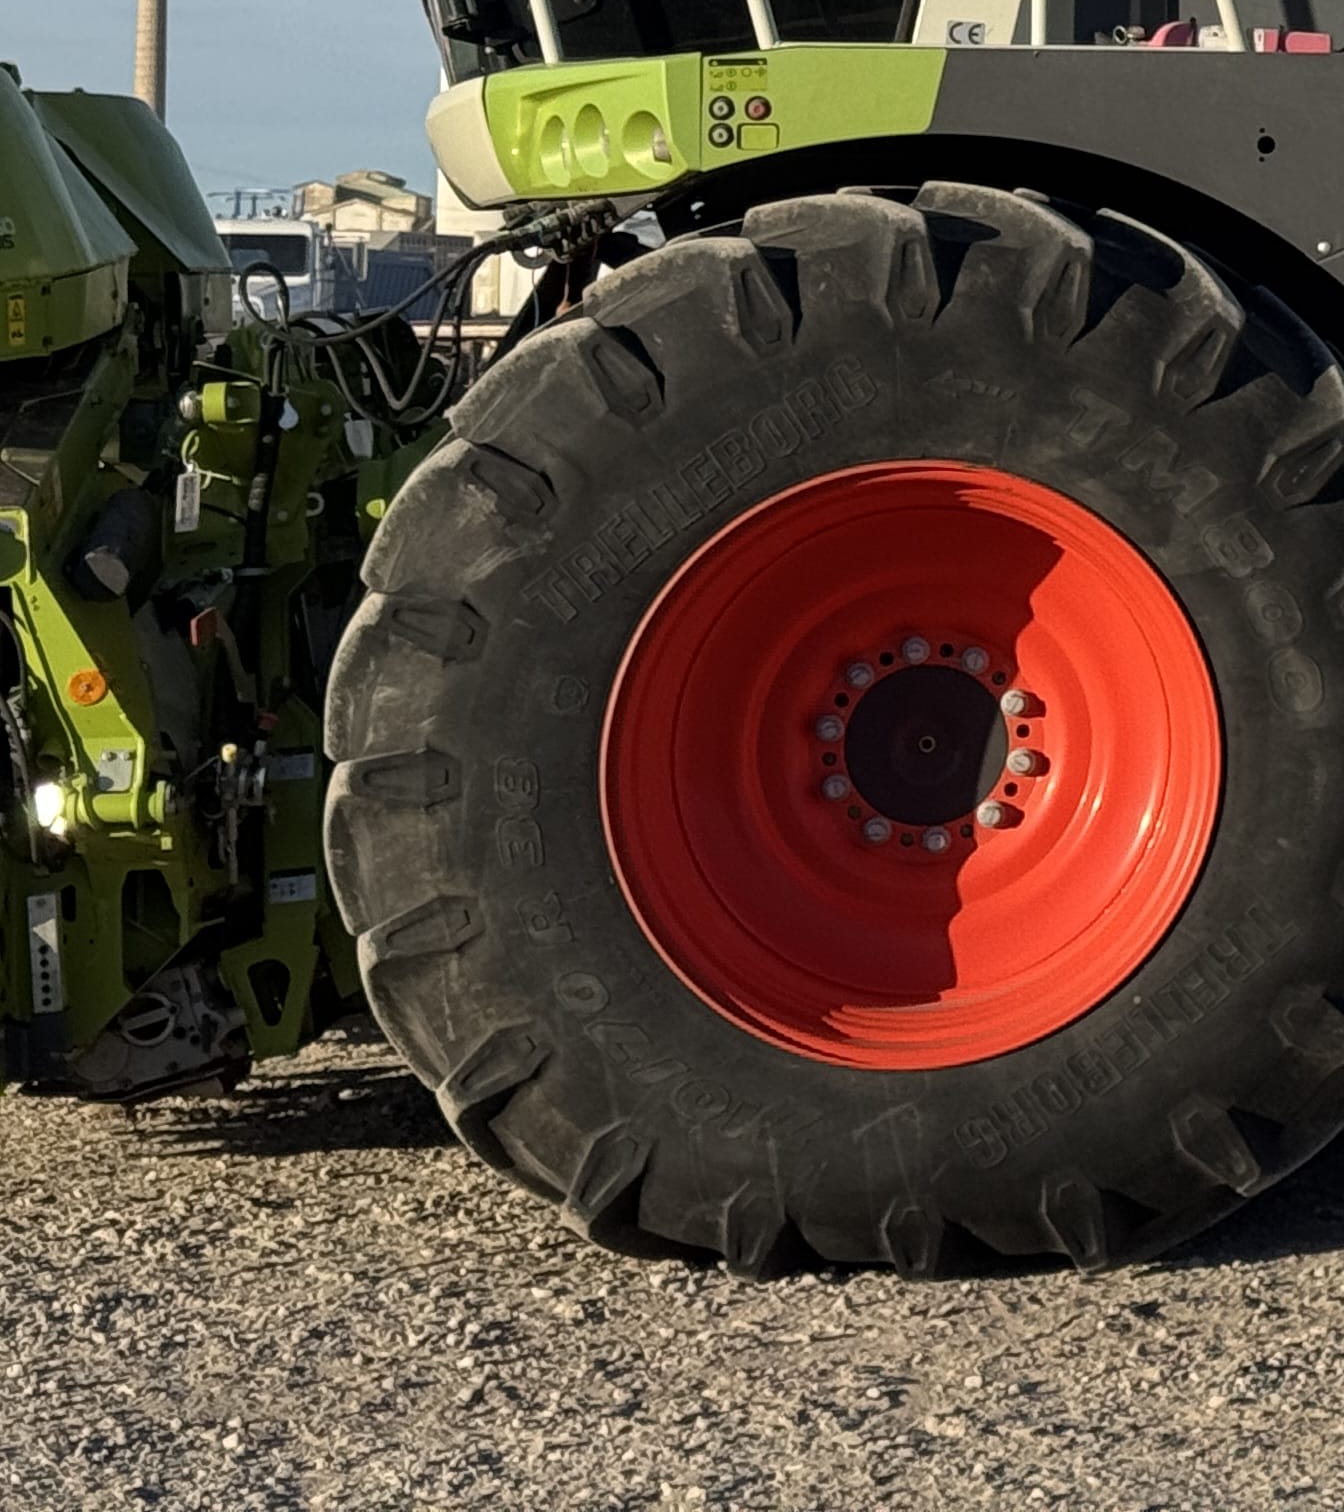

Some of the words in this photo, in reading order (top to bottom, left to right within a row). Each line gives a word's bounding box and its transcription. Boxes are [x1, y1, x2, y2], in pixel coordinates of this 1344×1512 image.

[949, 21, 983, 45] CE
[519, 353, 881, 625] TRELLEBORG
[1063, 384, 1326, 714] TM800
[492, 752, 547, 867] 38
[952, 900, 1304, 1171] TRELLEBORG
